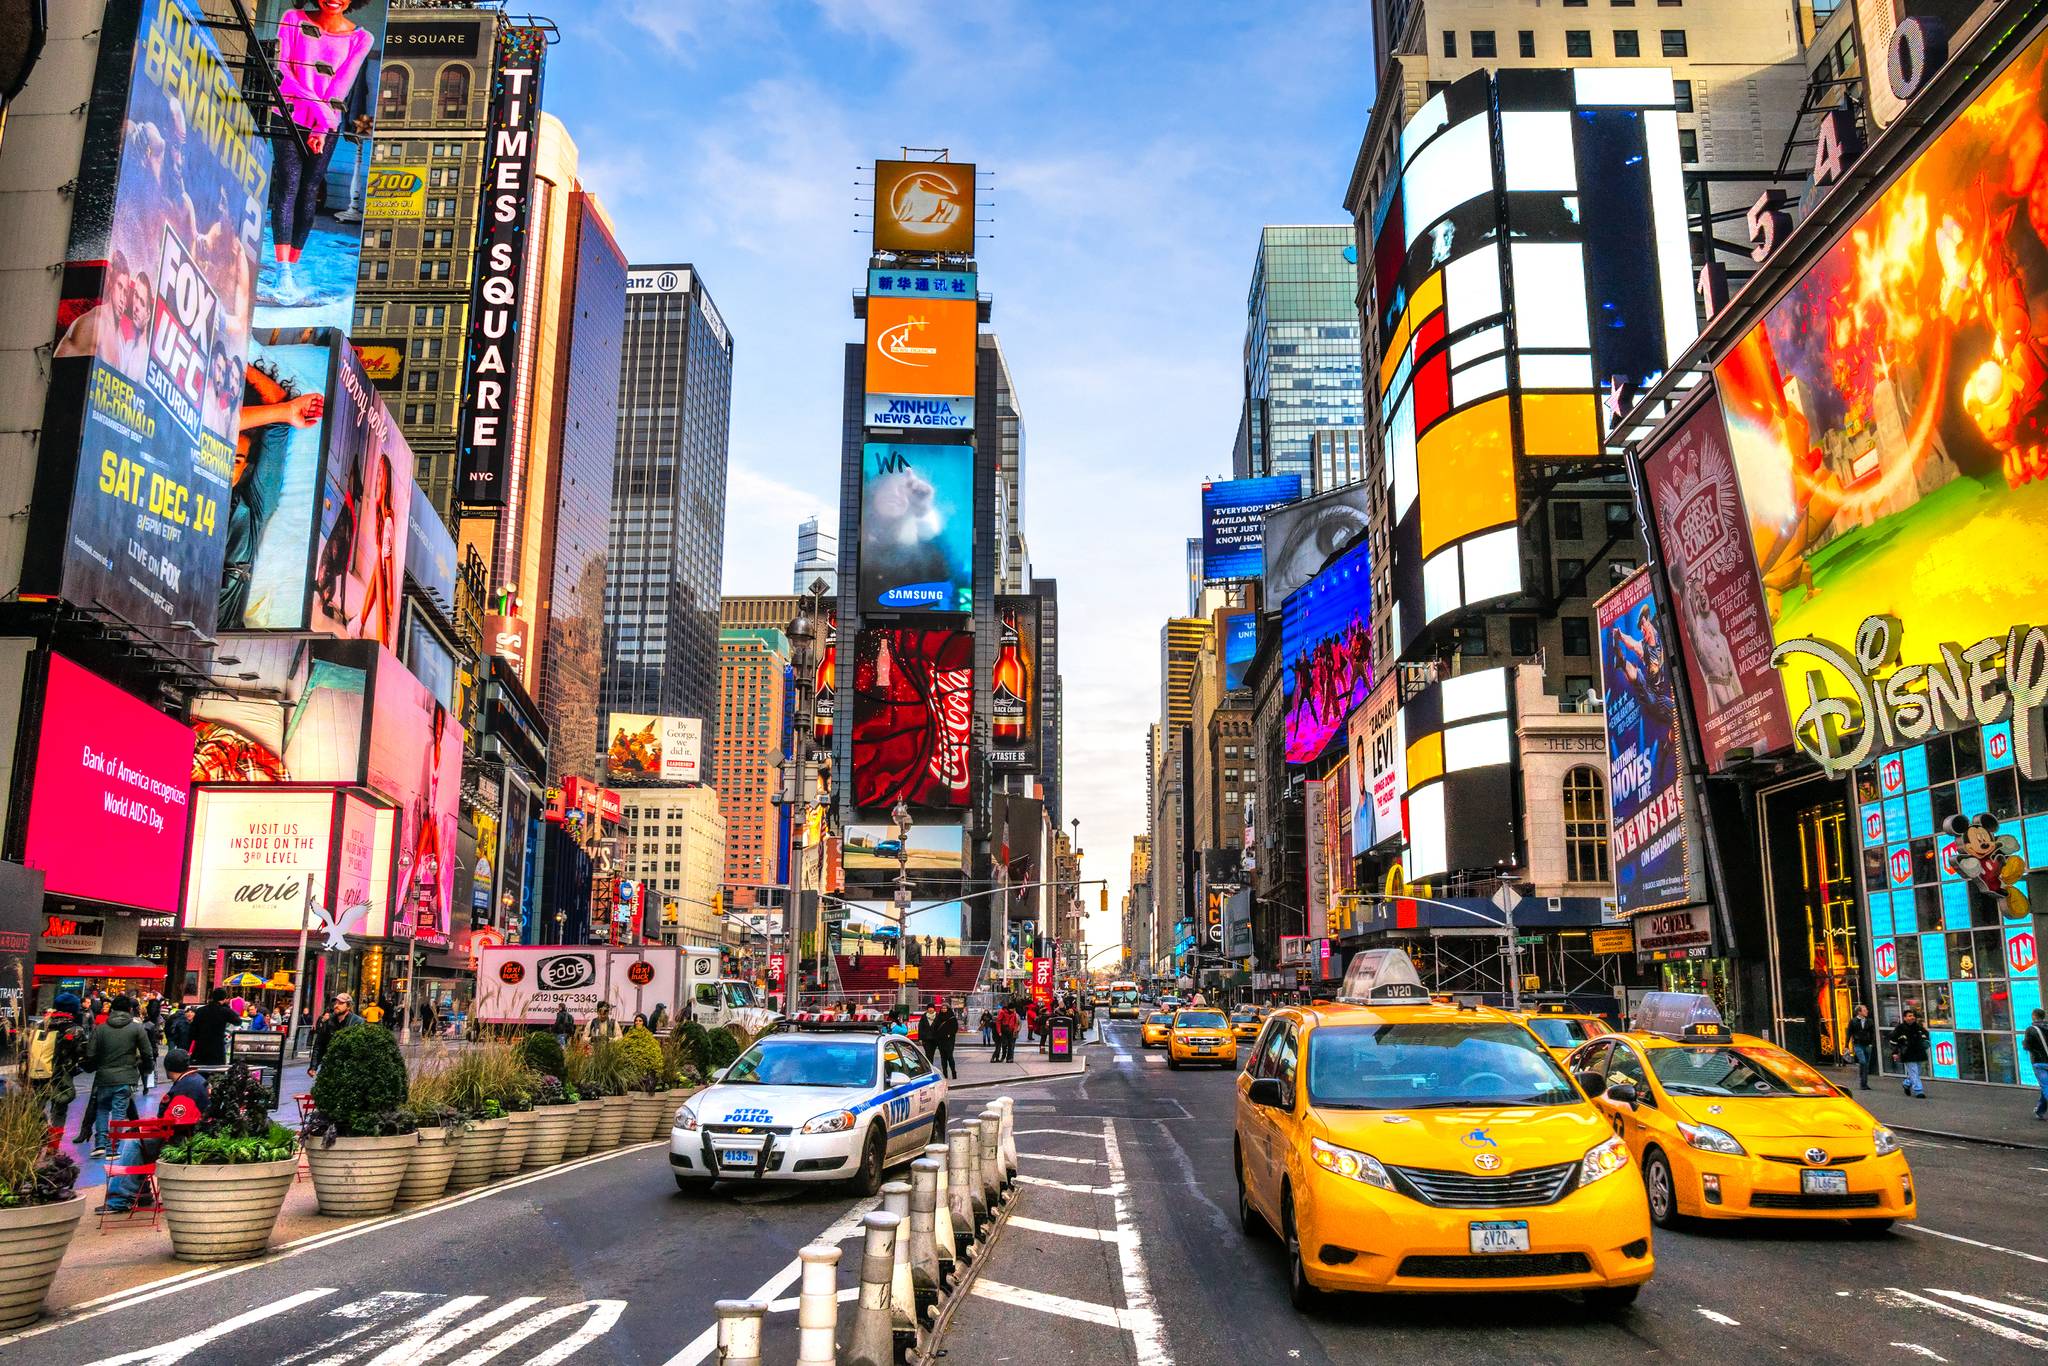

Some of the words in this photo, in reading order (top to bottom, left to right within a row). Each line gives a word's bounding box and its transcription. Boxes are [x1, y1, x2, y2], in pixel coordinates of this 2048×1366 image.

[408, 34, 465, 44] SQUARE
[151, 0, 258, 150] JOHNSON
[145, 25, 267, 201] BENAVIDEZ
[494, 68, 533, 223] TIMES
[241, 195, 263, 259] 2
[626, 278, 653, 288] anz
[878, 276, 965, 293] 新华通讯社
[158, 241, 216, 349] FOX
[472, 243, 515, 446] SQUARE
[154, 312, 204, 402] UFC
[97, 368, 135, 404] FABER
[148, 361, 201, 435] SATURDAY
[340, 358, 369, 428] merry
[368, 406, 388, 443] aerie
[888, 400, 952, 415] XINHUA
[94, 388, 156, 439] McDONALD
[874, 413, 911, 424] NEWS
[917, 414, 967, 426] AGENCY
[469, 472, 494, 481] NYC
[99, 450, 144, 507] SAT.
[148, 473, 190, 527] DEC.
[193, 494, 217, 537] 14
[1211, 516, 1247, 525] MATILDA
[1681, 495, 1714, 540] GREAT
[1215, 536, 1241, 544] KNOW
[1244, 534, 1263, 542] HOW
[1216, 526, 1238, 535] THEY
[1239, 525, 1259, 533] JUST
[1684, 515, 1720, 561] COMET
[127, 537, 147, 568] LIVE
[148, 555, 160, 577] ON
[160, 556, 182, 595] FOX
[888, 589, 944, 601] SAMSUNG
[1737, 631, 1768, 659] ORIGINAL
[666, 729, 698, 739] George,
[677, 721, 688, 730] By
[929, 661, 971, 790] Coca-Cola
[670, 747, 683, 755] did
[1372, 726, 1393, 778] LEVI
[1547, 738, 1572, 750] THE
[1577, 738, 1605, 751] SHO
[1611, 742, 1637, 775] NOTHING
[83, 745, 104, 773] Bank
[106, 755, 117, 777] of
[117, 761, 149, 790] America
[150, 779, 186, 806] recognizes
[1612, 747, 1652, 806] MOVES
[1637, 780, 1652, 803] LIKE
[104, 791, 128, 818] World
[128, 801, 148, 825] AIDS
[149, 807, 164, 834] Day.
[249, 823, 278, 835] VISIT
[283, 823, 298, 835] US
[230, 838, 269, 849] INSIDE
[273, 838, 289, 849] ON
[294, 838, 314, 849] THE
[1313, 790, 1326, 904] PALACE
[243, 852, 262, 863] 3RD
[265, 852, 298, 863] LEVEL
[1640, 847, 1650, 868] ON
[233, 876, 300, 902] aerie
[1652, 912, 1695, 935] DIGITAL
[1688, 948, 1707, 957] SONY
[503, 966, 521, 974] taxi
[549, 963, 584, 981] edge
[632, 966, 650, 974] taxi
[771, 957, 783, 980] tkts
[1037, 961, 1049, 985] tkts
[531, 993, 551, 1002] (212)
[552, 993, 598, 1003] 947-3343
[1696, 1025, 1718, 1034] 7L66
[723, 1115, 774, 1123] POLICE
[890, 1096, 911, 1126] NYPD
[724, 1151, 748, 1161] 4135
